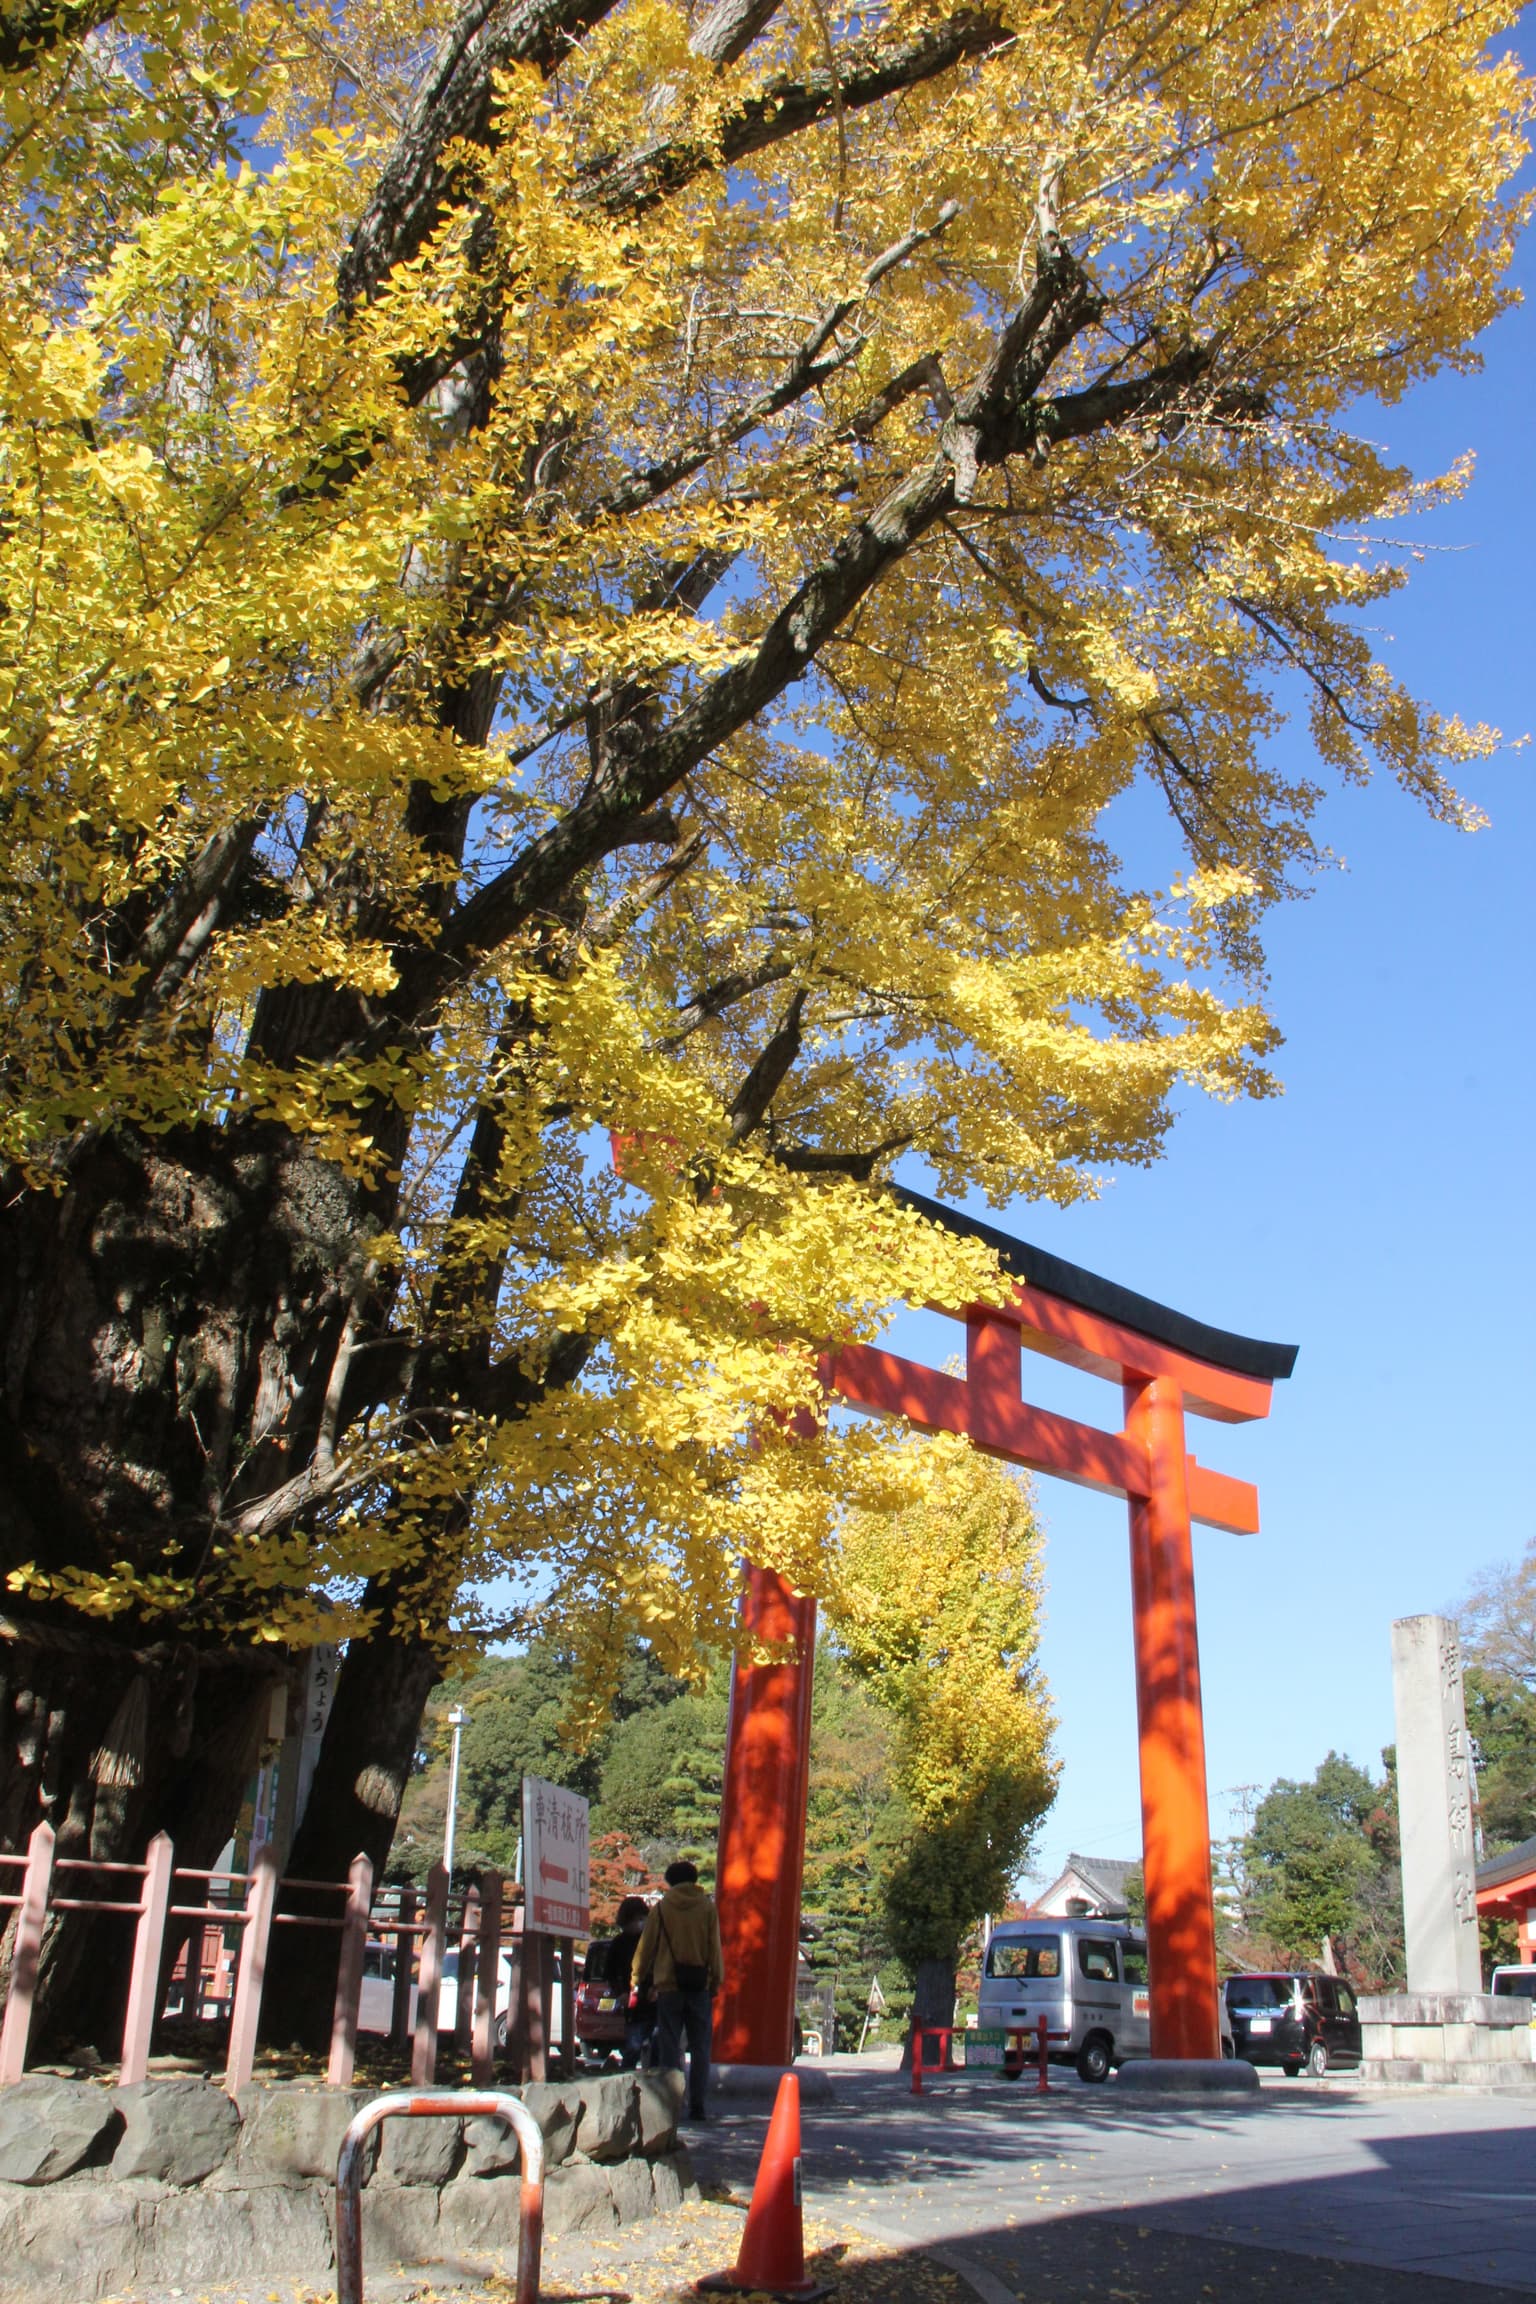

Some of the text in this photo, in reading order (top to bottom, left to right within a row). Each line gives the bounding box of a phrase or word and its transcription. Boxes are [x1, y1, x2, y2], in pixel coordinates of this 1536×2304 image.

[1440, 1638, 1475, 1923] 津島神社
[572, 1867, 586, 1893] 入口
